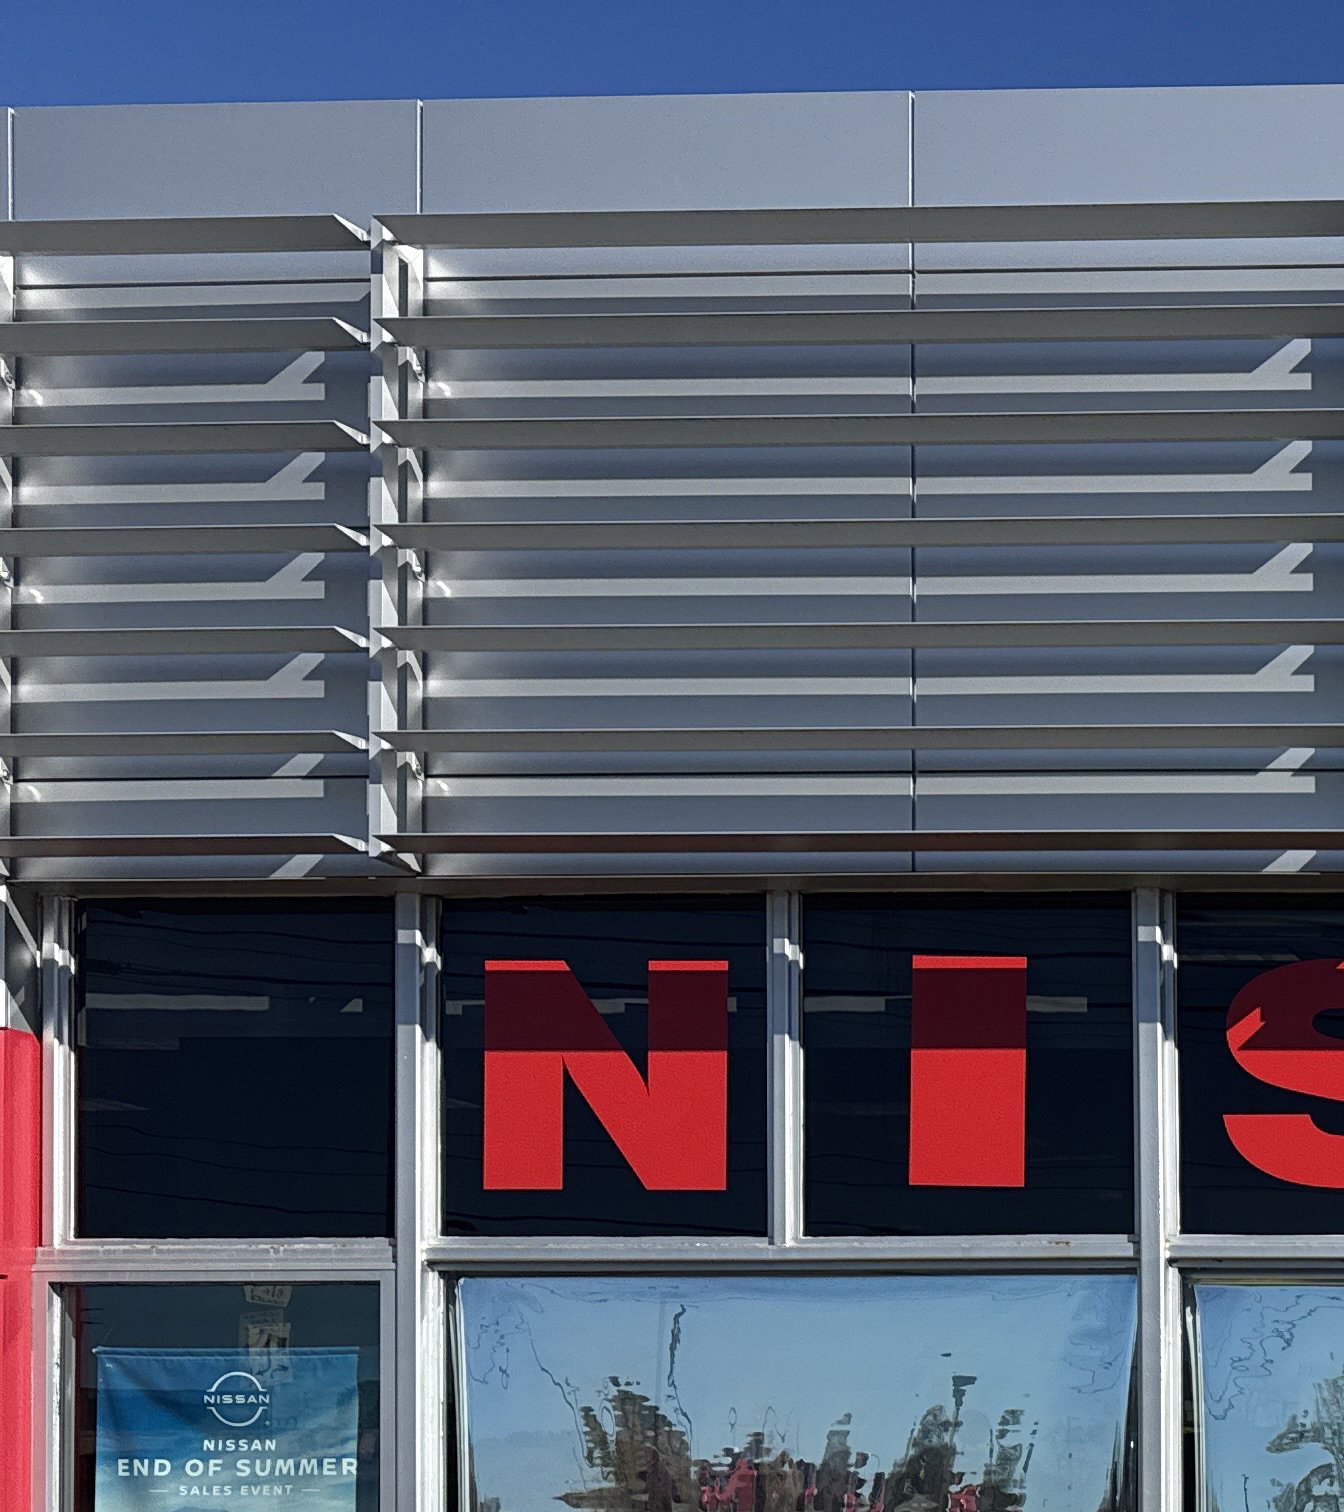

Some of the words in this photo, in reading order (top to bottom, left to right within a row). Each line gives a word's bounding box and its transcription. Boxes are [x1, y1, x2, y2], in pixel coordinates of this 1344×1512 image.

[203, 1394, 270, 1404] NISSAN
[203, 1438, 277, 1451] NISSAN
[117, 1458, 172, 1477] END
[185, 1458, 223, 1477] OF
[235, 1458, 358, 1477] SUMMER
[179, 1485, 232, 1496] SALES
[240, 1484, 294, 1496] EVENT
